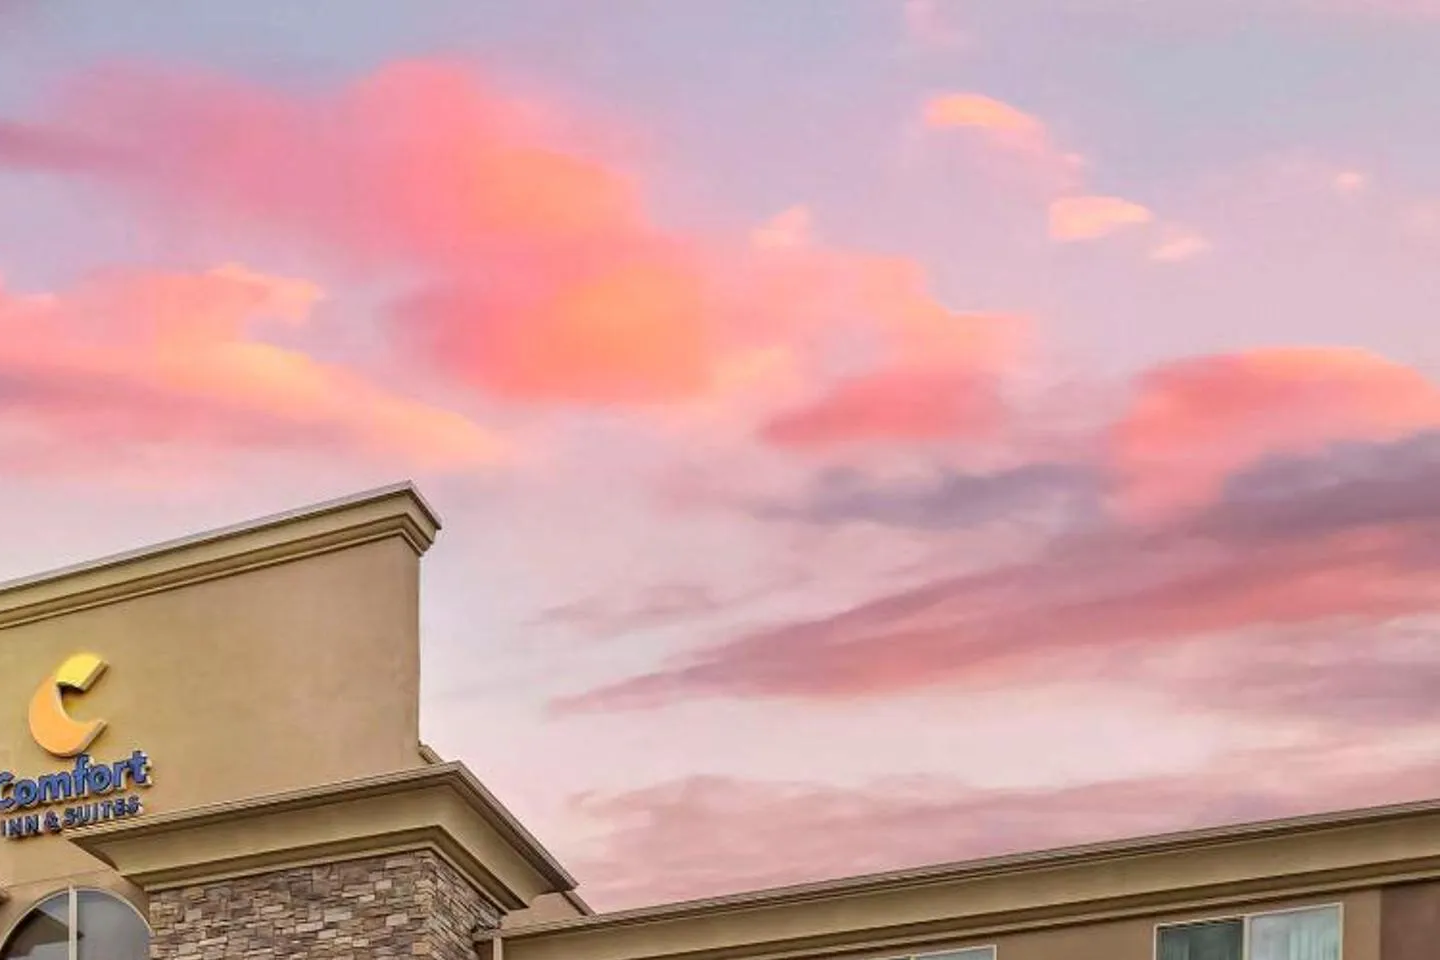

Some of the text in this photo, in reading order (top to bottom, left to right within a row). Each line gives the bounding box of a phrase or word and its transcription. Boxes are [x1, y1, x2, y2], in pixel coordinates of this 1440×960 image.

[0, 796, 141, 837] INN & SUITES
